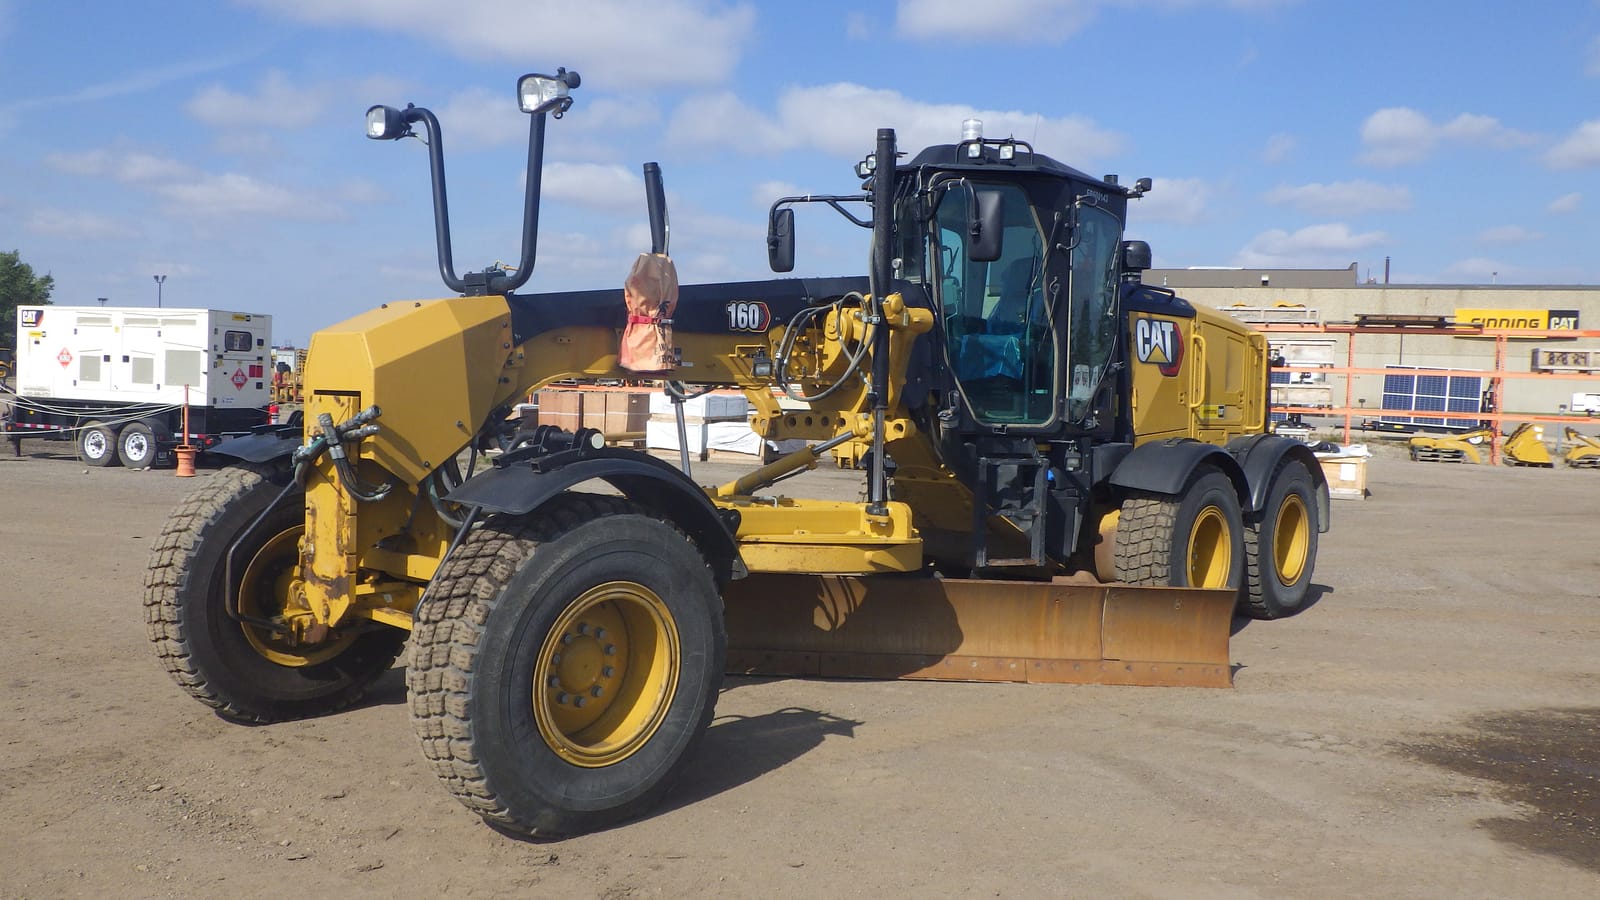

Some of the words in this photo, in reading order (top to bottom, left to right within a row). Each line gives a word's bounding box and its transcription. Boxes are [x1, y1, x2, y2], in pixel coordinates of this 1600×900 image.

[23, 311, 37, 322] CAT
[728, 303, 759, 329] 160
[1550, 316, 1577, 330] CAT
[1137, 319, 1174, 363] CAT
